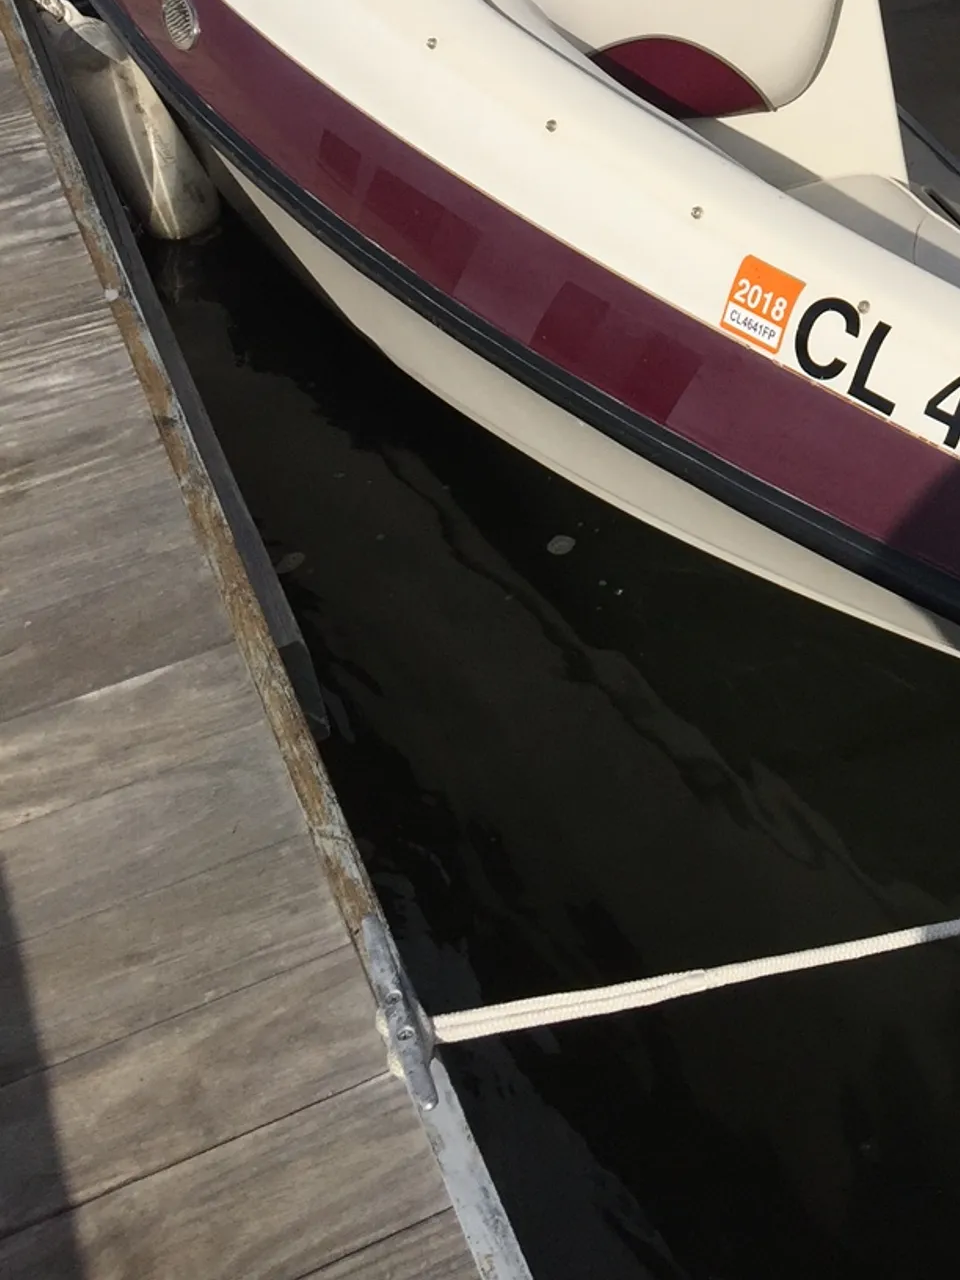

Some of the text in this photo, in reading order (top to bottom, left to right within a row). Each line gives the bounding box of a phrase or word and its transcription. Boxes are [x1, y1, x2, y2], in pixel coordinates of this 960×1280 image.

[733, 278, 788, 322] 2018
[729, 308, 777, 340] CL4641FP
[794, 297, 896, 417] CL
